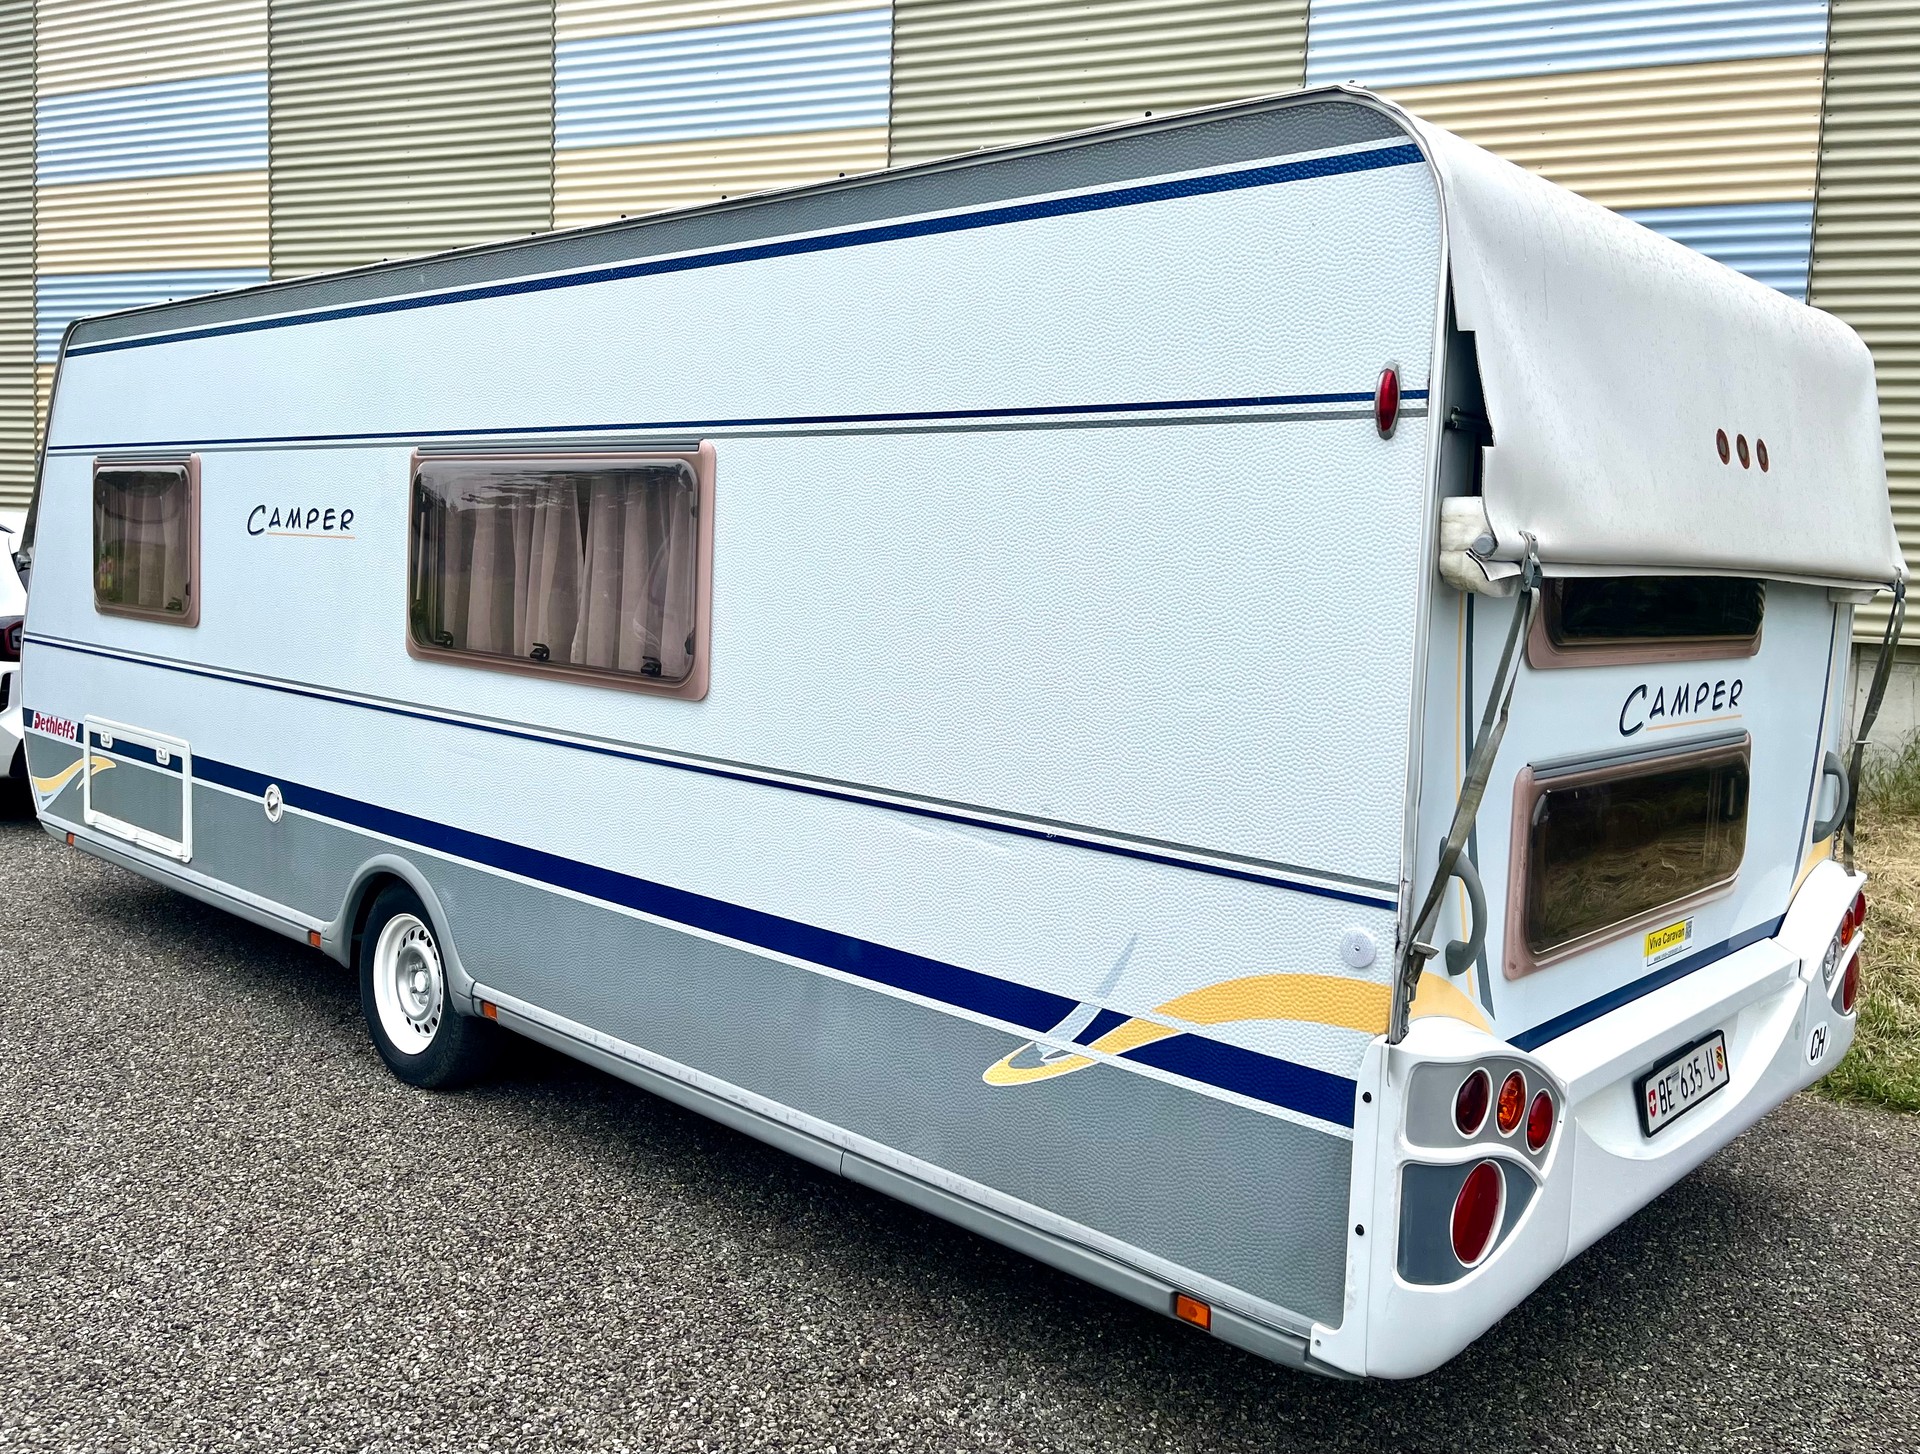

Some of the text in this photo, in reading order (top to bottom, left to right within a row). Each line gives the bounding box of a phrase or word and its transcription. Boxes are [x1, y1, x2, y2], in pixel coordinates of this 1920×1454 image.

[247, 504, 354, 536] CAMPER
[1619, 678, 1743, 737] CAMPER
[34, 712, 75, 740] Dethleffs
[1649, 928, 1685, 950] Viva Caravan
[1810, 1025, 1827, 1061] CH
